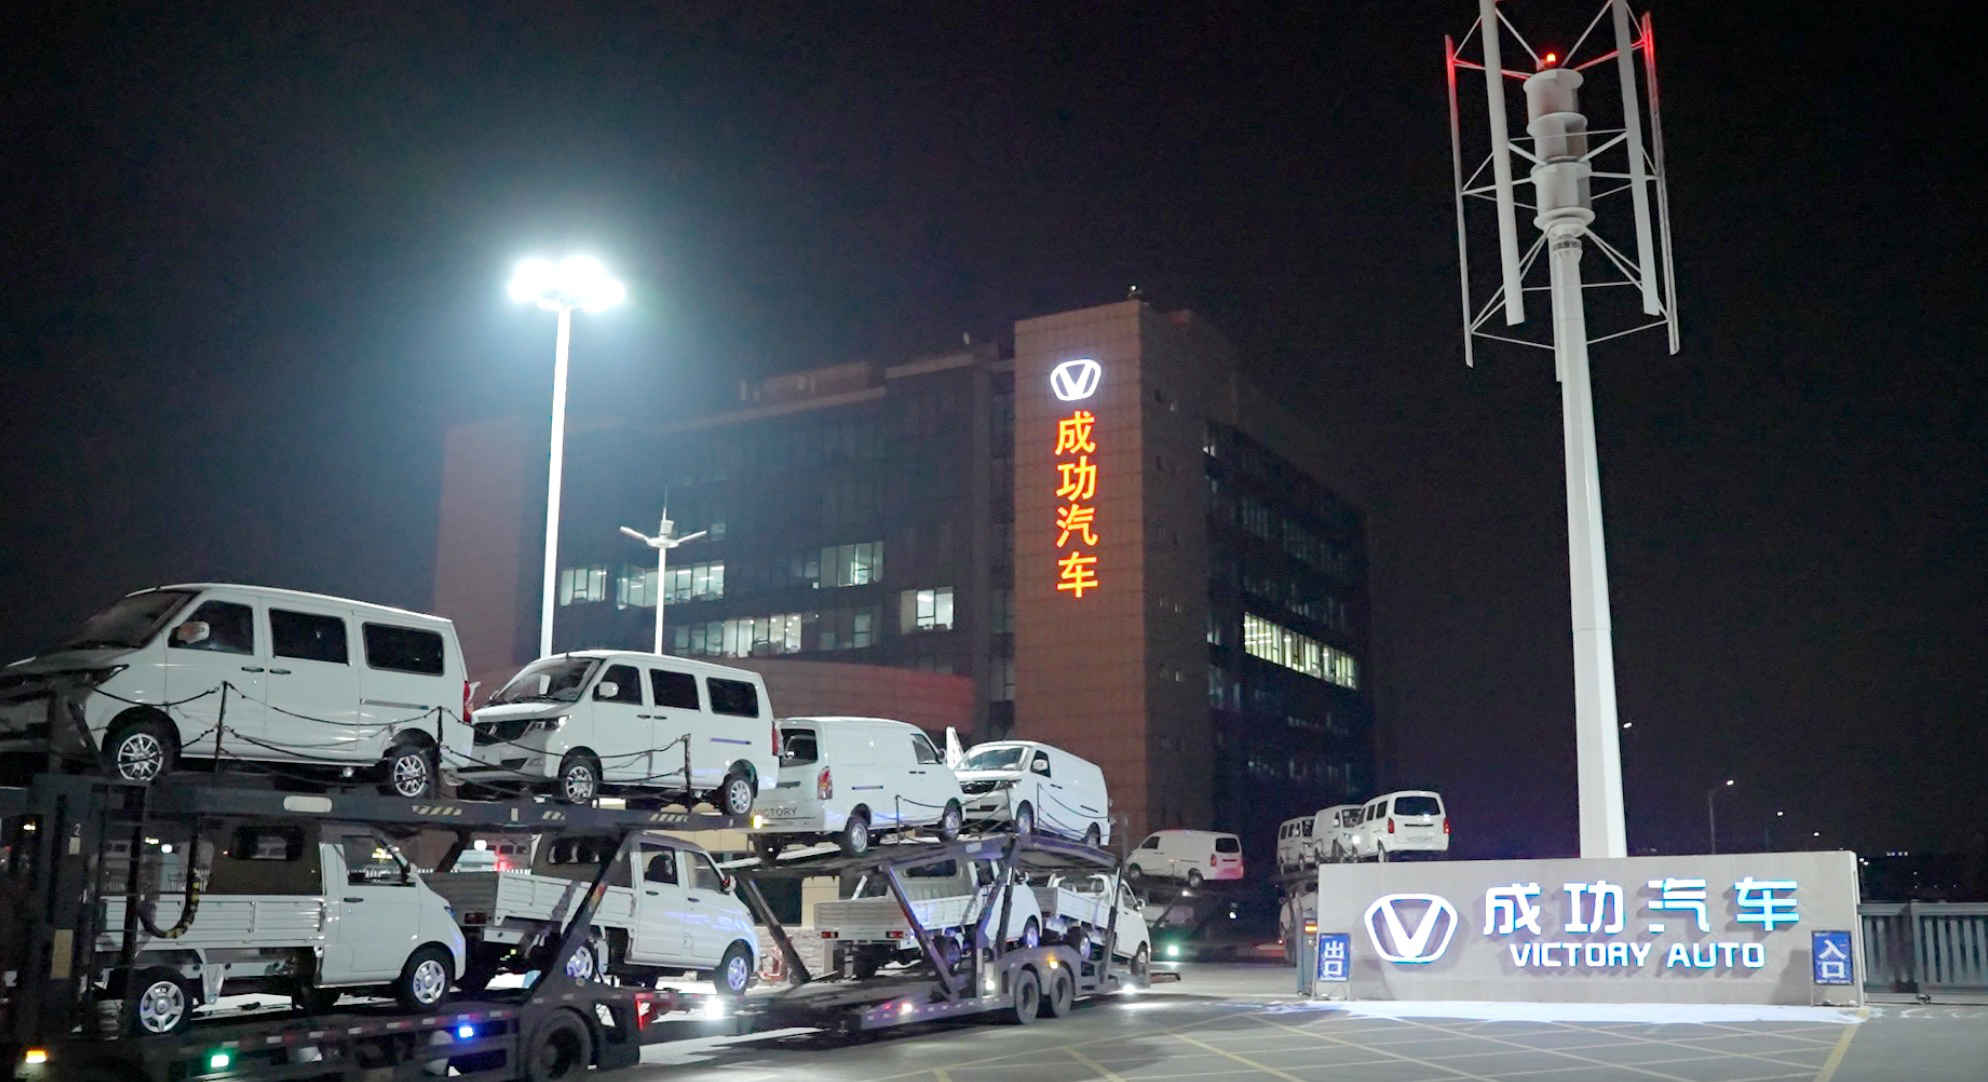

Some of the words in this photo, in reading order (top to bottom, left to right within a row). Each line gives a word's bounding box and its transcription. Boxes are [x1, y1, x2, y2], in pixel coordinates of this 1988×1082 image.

[1055, 410, 1098, 598] 成功汽车
[1484, 877, 1799, 936] 成功汽车
[1324, 940, 1344, 976] 出口
[1509, 941, 1652, 967] VICTORY
[1666, 942, 1765, 969] AUTO
[1818, 939, 1847, 979] 入口
